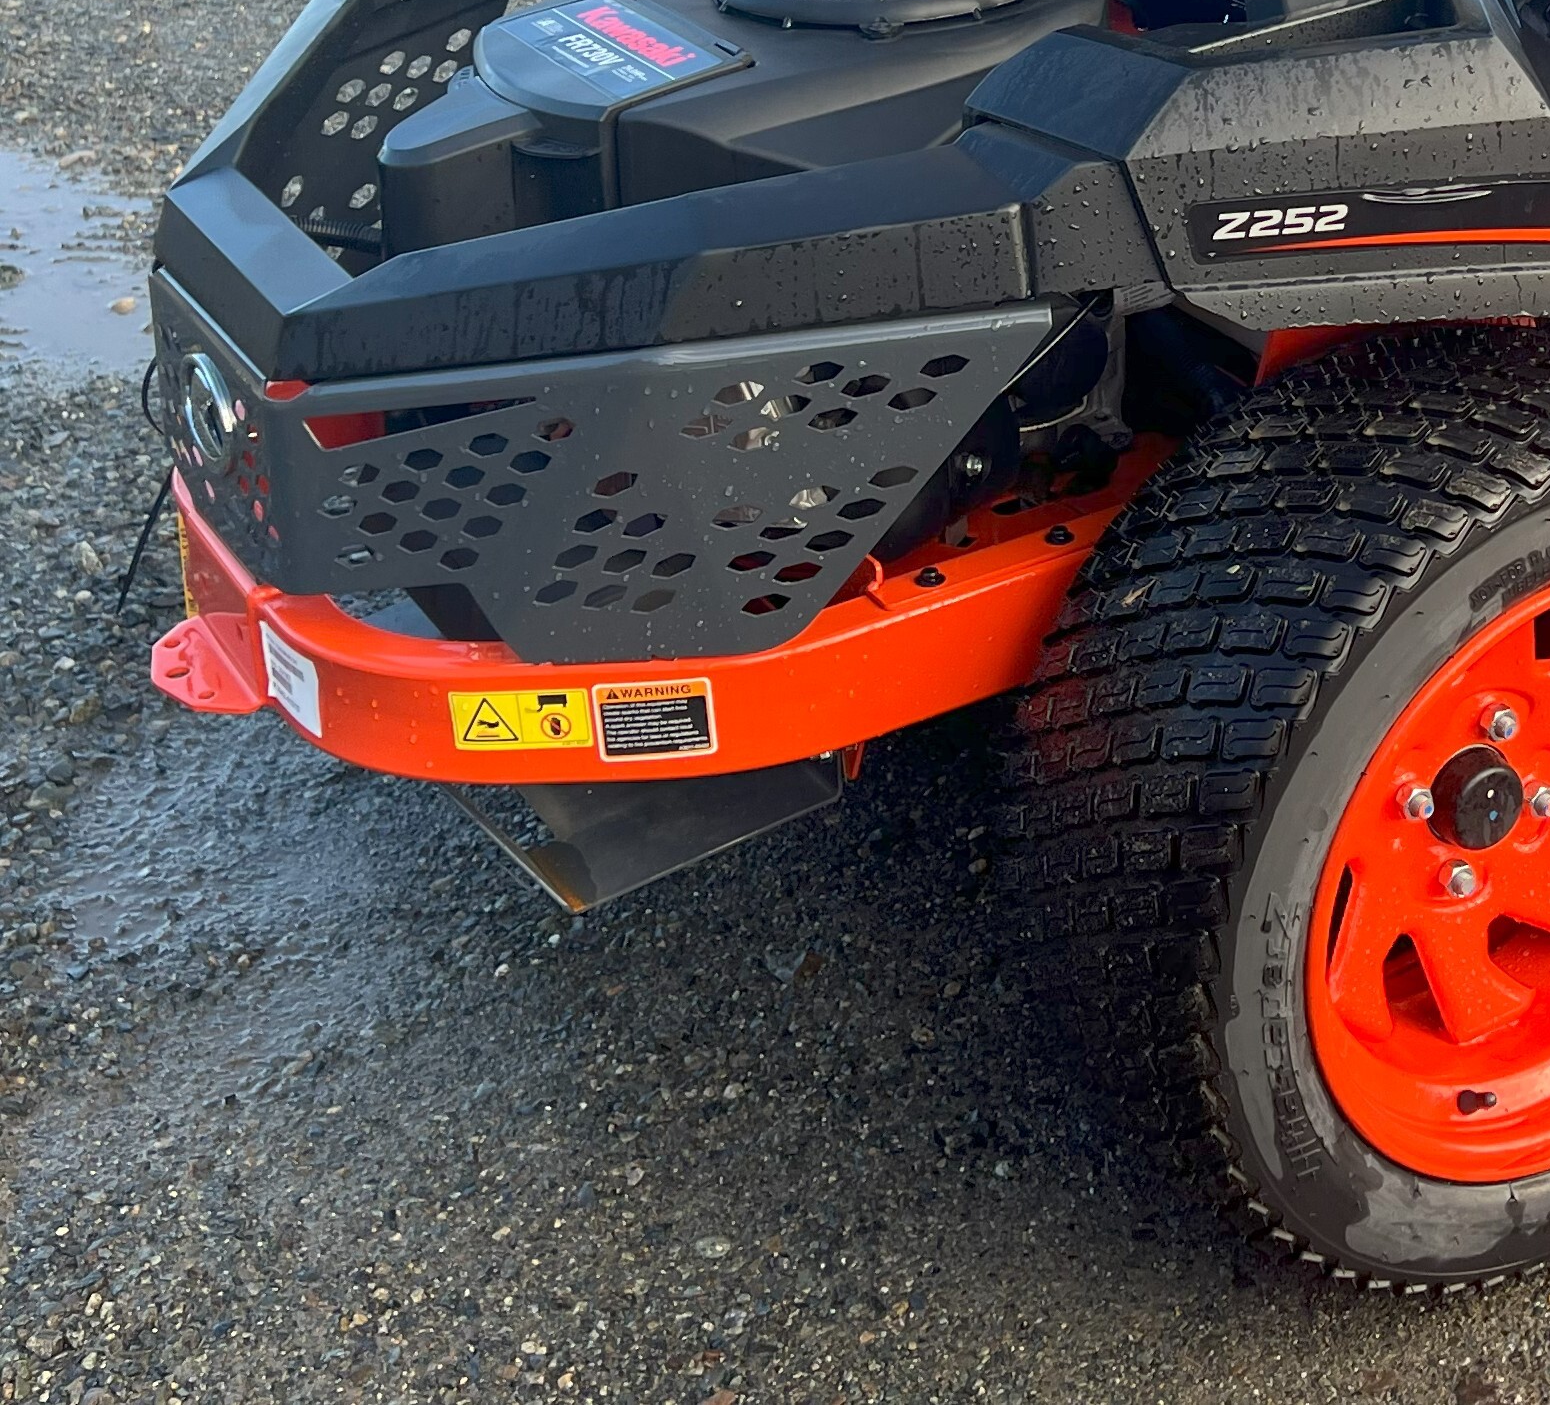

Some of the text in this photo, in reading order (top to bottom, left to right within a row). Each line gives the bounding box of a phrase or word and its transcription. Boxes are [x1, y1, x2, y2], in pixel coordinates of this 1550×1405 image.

[558, 33, 625, 66] FR730V
[577, 6, 697, 68] Kawasaki
[1212, 204, 1350, 242] Z252
[619, 684, 692, 699] WARNING
